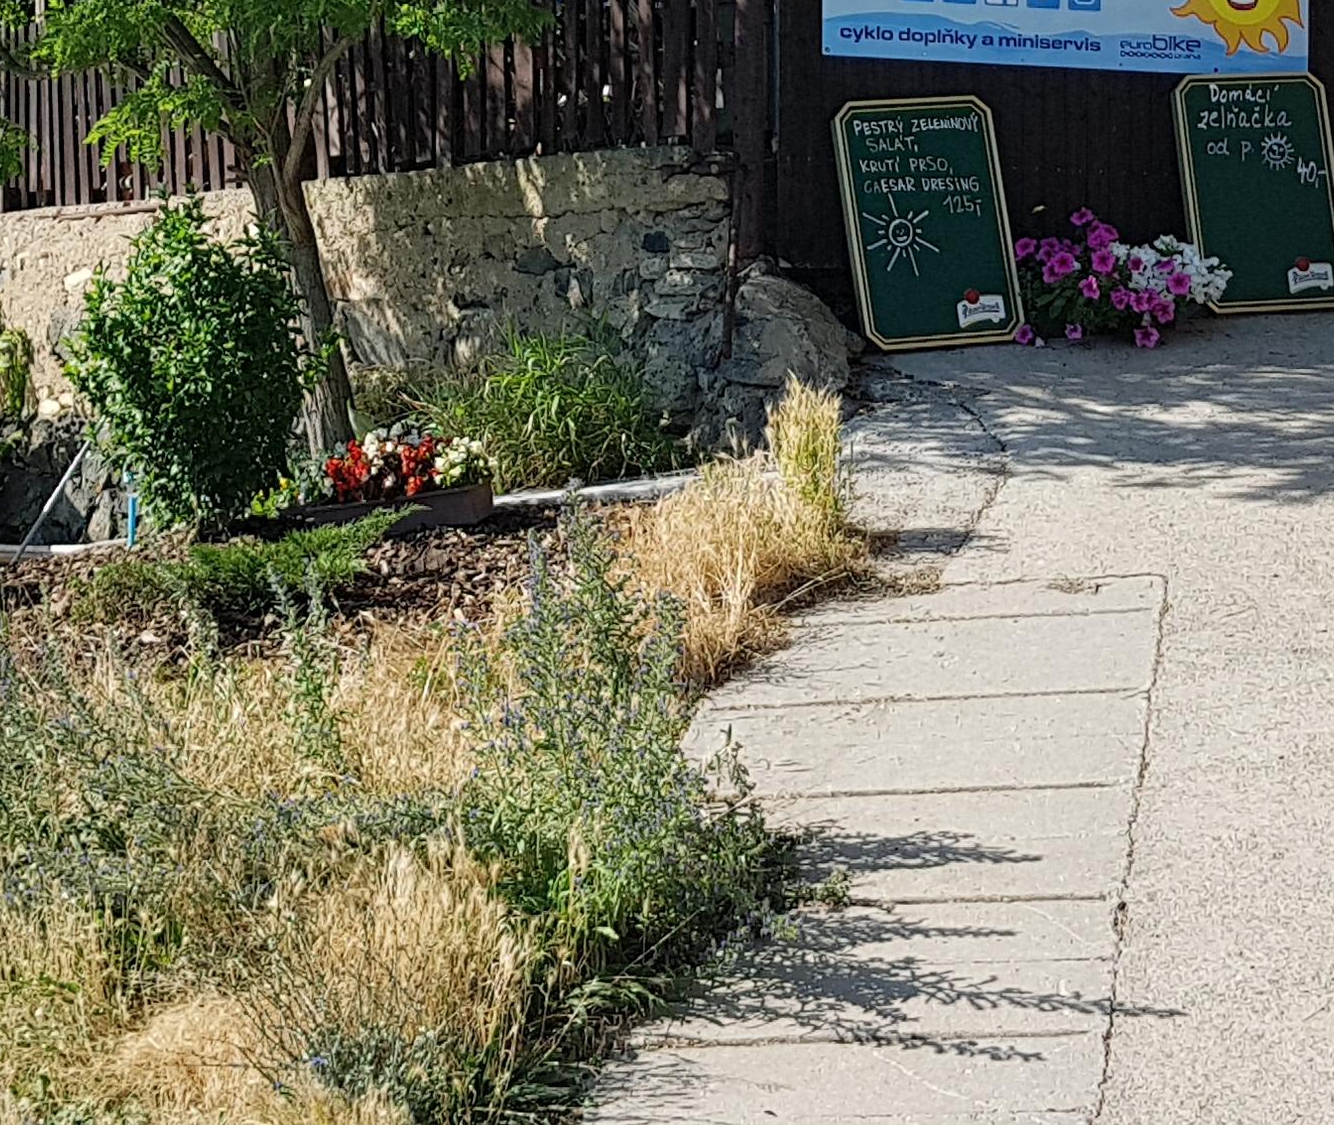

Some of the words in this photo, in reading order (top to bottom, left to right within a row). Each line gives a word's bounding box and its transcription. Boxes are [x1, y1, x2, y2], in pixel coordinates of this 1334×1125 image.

[839, 25, 894, 42] cyklo
[898, 27, 977, 49] doplňky
[981, 34, 994, 47] a
[998, 34, 1102, 52] miniservis
[1209, 83, 1280, 104] Domácí
[852, 116, 904, 136] PESTRÝ
[1197, 104, 1292, 130] zelňačka
[1207, 137, 1230, 155] od
[859, 155, 900, 173] KRUTÍ
[863, 177, 916, 194] CAESAR
